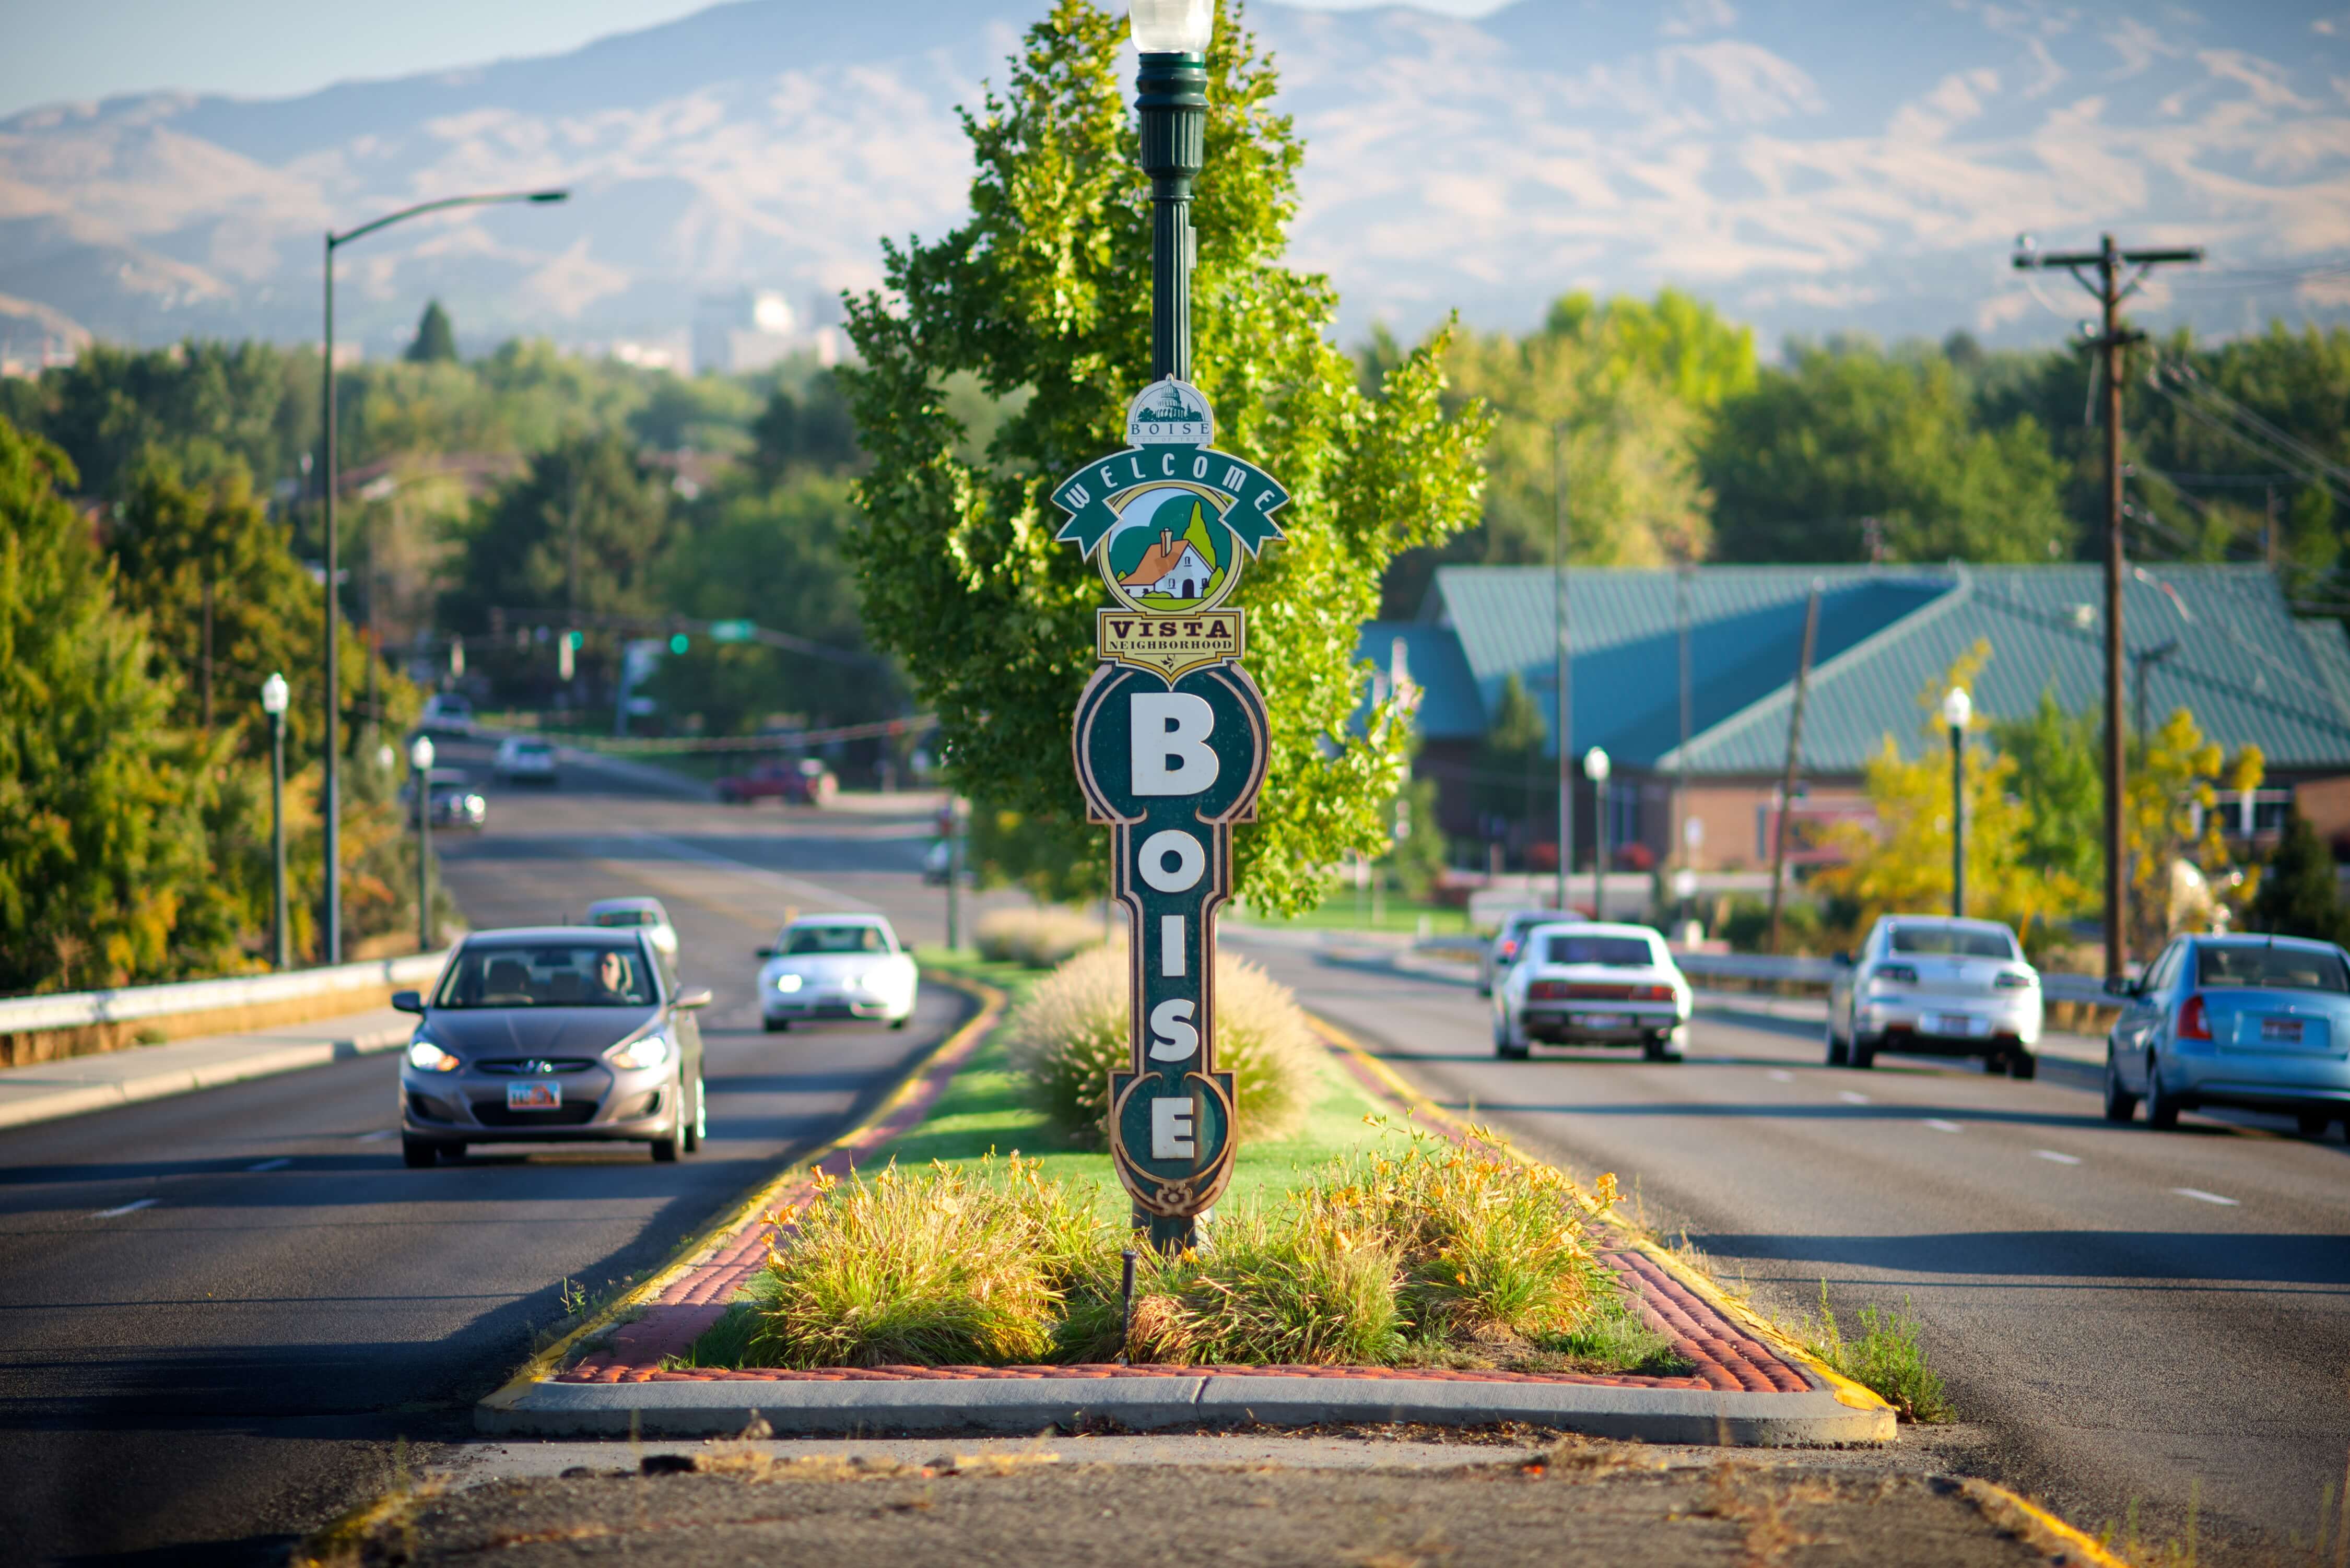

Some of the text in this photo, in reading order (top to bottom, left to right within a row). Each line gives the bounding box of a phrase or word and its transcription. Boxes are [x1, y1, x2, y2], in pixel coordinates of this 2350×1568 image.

[1131, 423, 1209, 435] BOISE
[1064, 453, 1276, 512] WELCOME
[1109, 620, 1232, 639] VISTA
[1109, 640, 1232, 650] NEIGHBORHOOD
[1130, 692, 1219, 1160] BOISE
